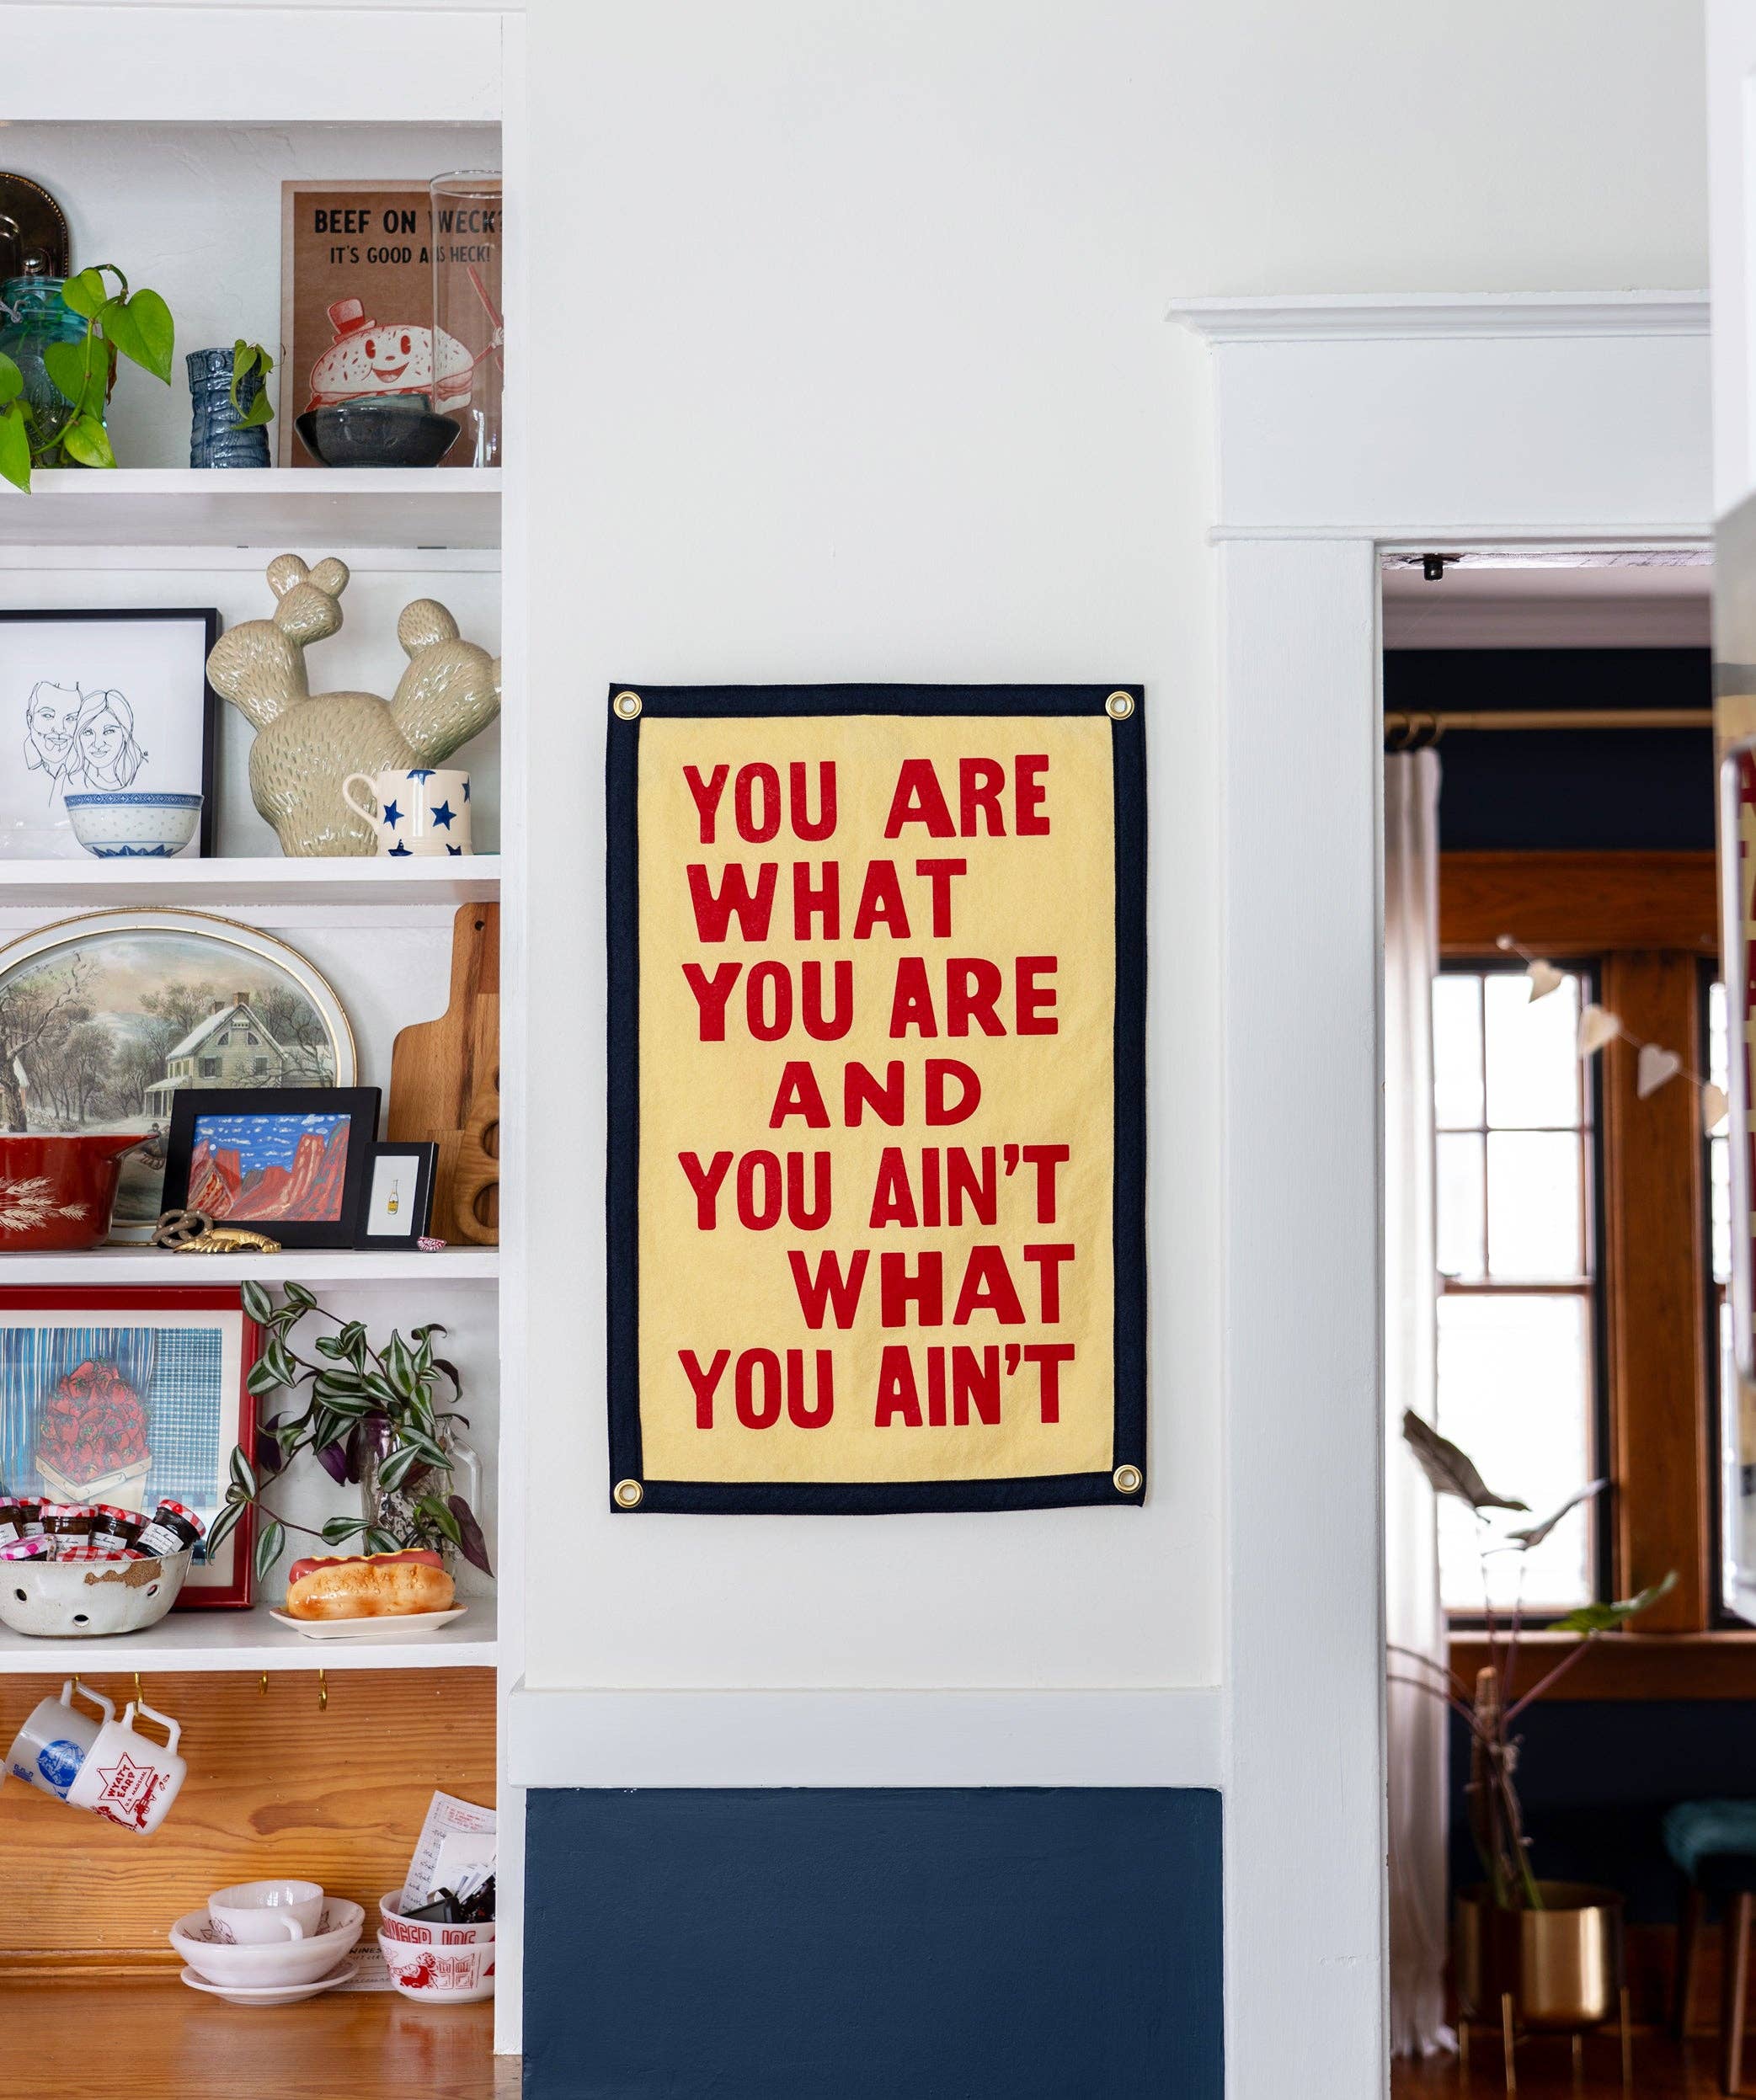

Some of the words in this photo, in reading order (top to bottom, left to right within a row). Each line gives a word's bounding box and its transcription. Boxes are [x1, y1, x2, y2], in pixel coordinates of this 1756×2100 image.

[315, 210, 371, 233] BEEF
[383, 210, 416, 233] ON
[330, 245, 360, 264] IT'S
[367, 247, 412, 264] GOOD
[450, 246, 490, 263] HECK!
[683, 761, 837, 844] YOU
[884, 754, 1050, 839] ARE
[686, 859, 967, 942] WHAT
[682, 961, 853, 1042] YOU
[889, 956, 1058, 1038] ARE
[769, 1059, 981, 1128] AND
[678, 1150, 831, 1231] YOU
[869, 1143, 1070, 1229] AIN'T
[787, 1244, 1075, 1330] WHAT
[678, 1348, 834, 1430] YOU
[875, 1344, 1075, 1427] AIN'T
[107, 1765, 131, 1797] WYATT
[116, 1772, 136, 1798] EARP
